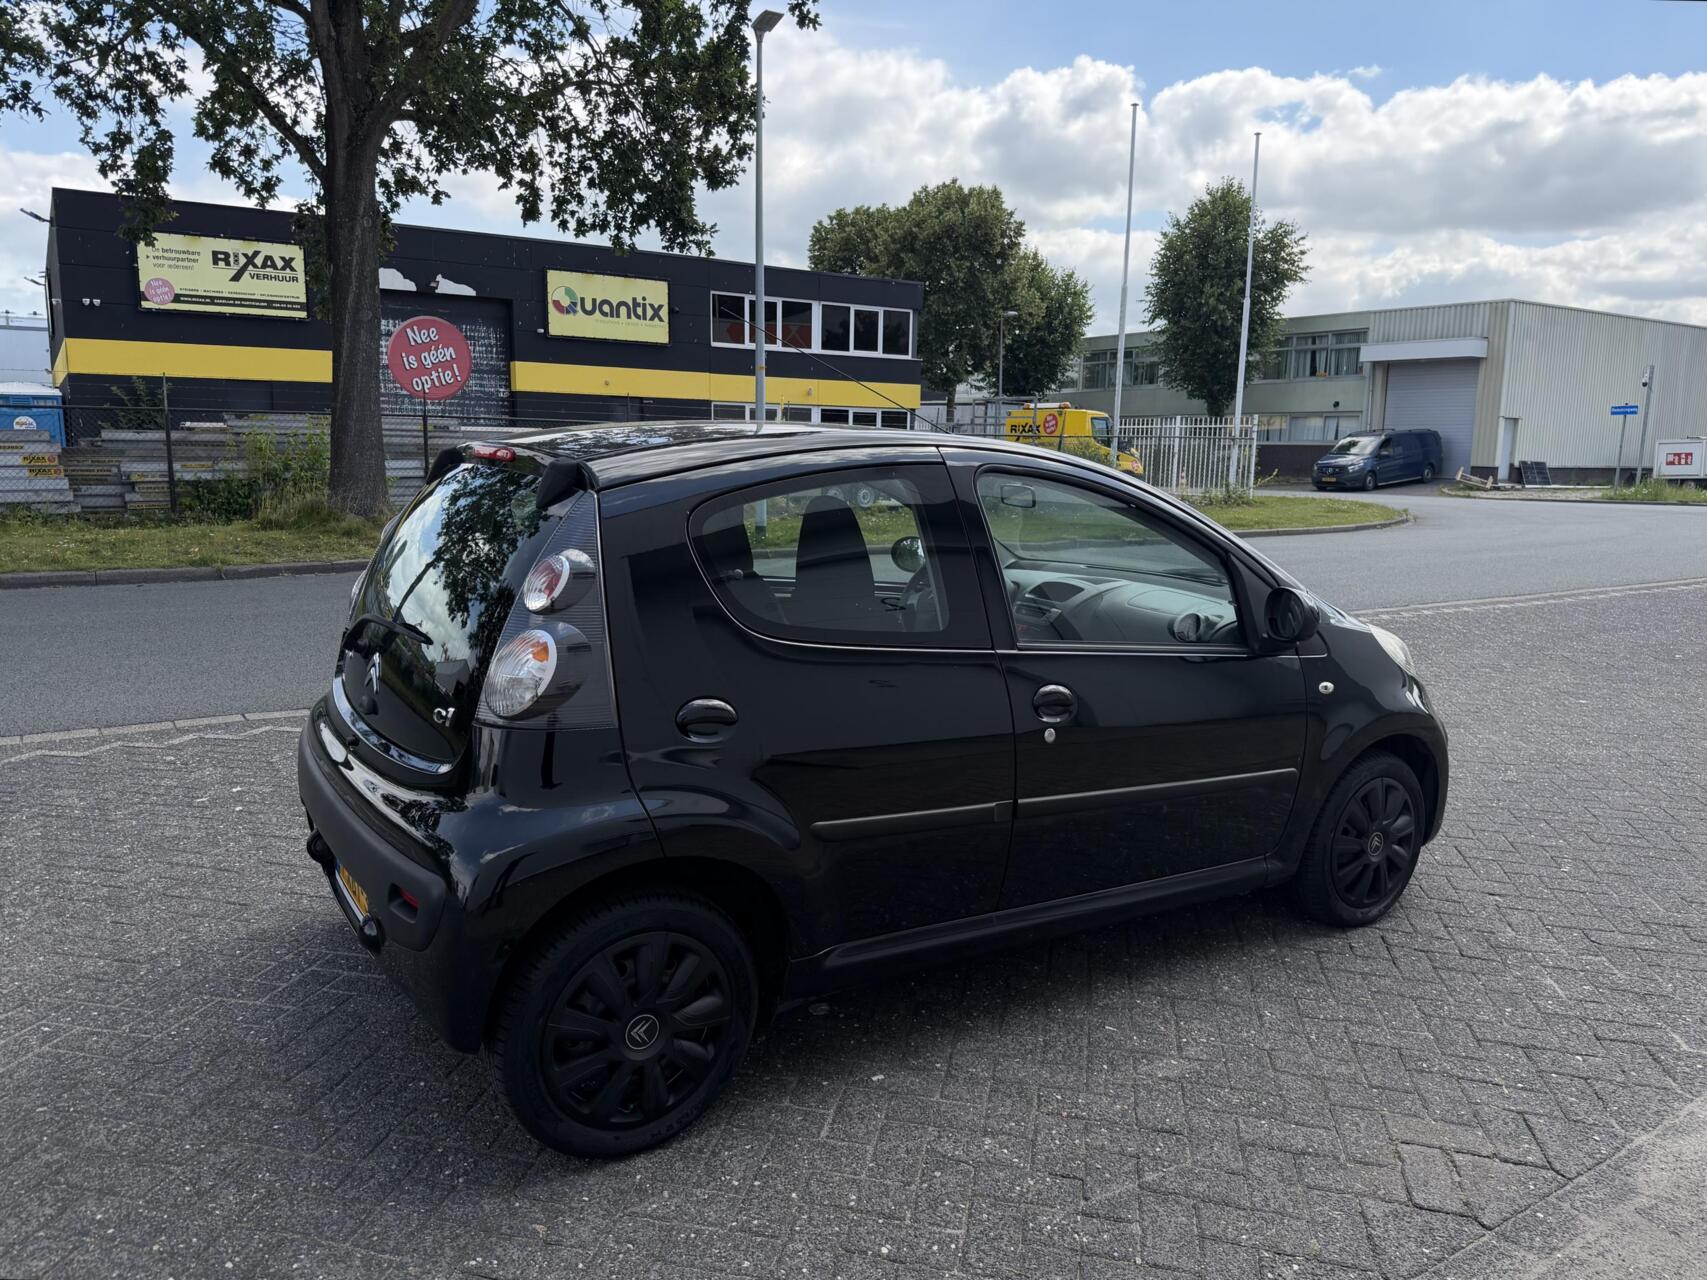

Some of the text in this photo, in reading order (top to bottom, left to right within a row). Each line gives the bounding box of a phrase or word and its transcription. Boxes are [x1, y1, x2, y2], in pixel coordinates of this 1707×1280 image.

[152, 255, 199, 263] verhuurpartner
[161, 247, 201, 256] betrouwbare
[212, 250, 298, 282] RIXAX
[249, 272, 299, 283] VERHUUR
[406, 325, 439, 346] Nee
[401, 343, 456, 370] is géén
